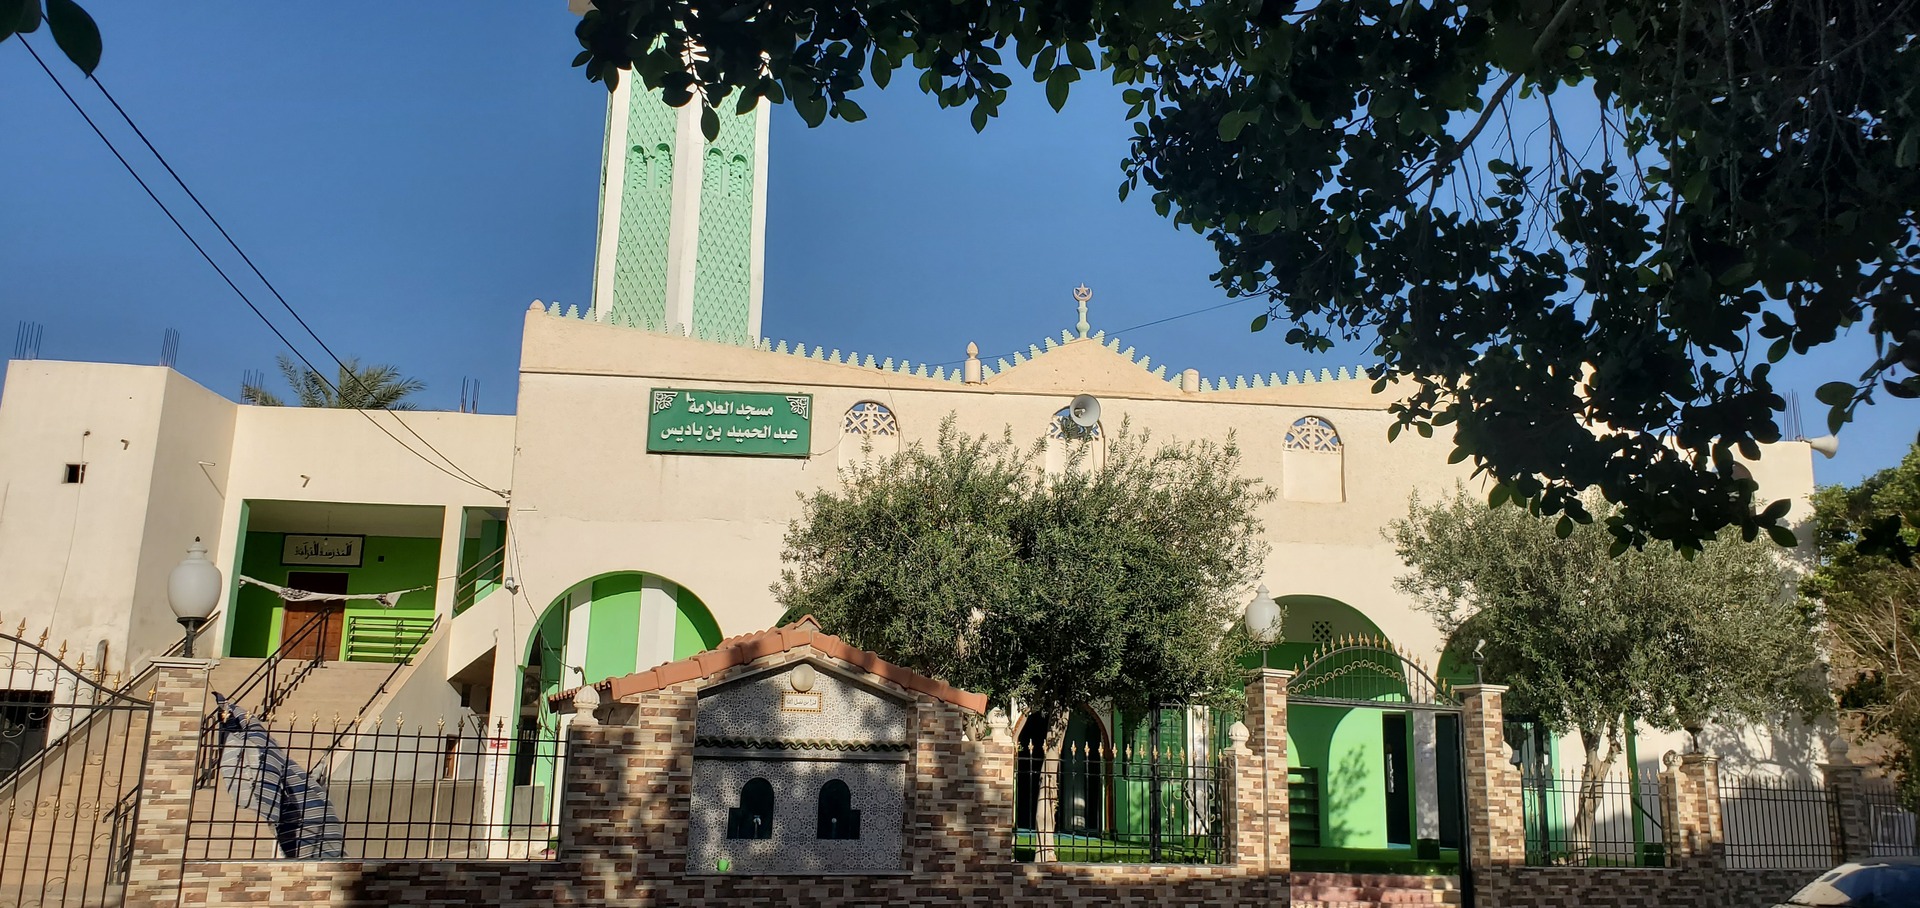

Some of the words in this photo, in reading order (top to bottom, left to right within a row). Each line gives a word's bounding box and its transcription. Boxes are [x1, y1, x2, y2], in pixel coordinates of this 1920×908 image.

[687, 397, 734, 417] العلامة
[736, 402, 774, 421] مسجد
[660, 421, 704, 442] باديس
[705, 424, 722, 441] بن
[726, 424, 772, 443] الحميد
[773, 427, 799, 443] عبد
